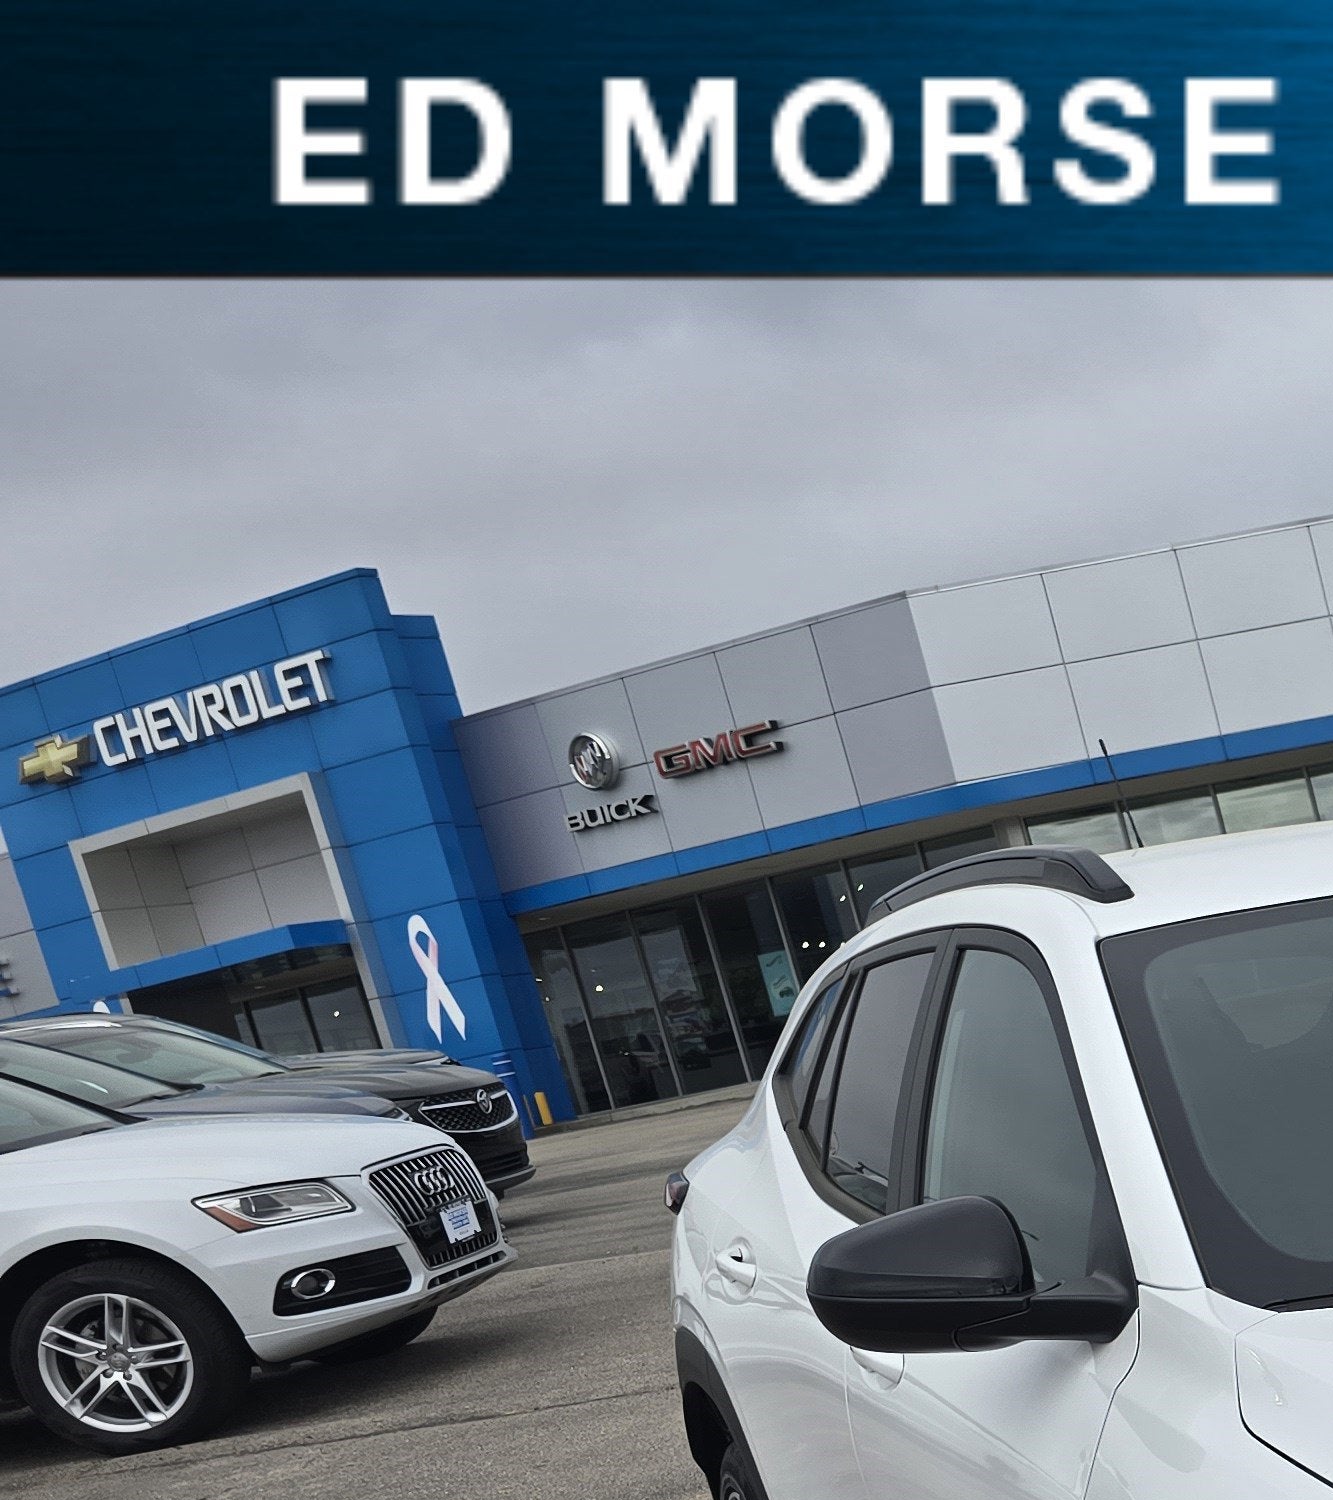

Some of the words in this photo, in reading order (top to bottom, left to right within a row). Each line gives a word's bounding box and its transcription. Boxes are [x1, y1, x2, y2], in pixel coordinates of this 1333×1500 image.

[93, 649, 333, 768] CHEVROLET
[654, 720, 784, 780] GMC
[565, 794, 658, 833] BUICK
